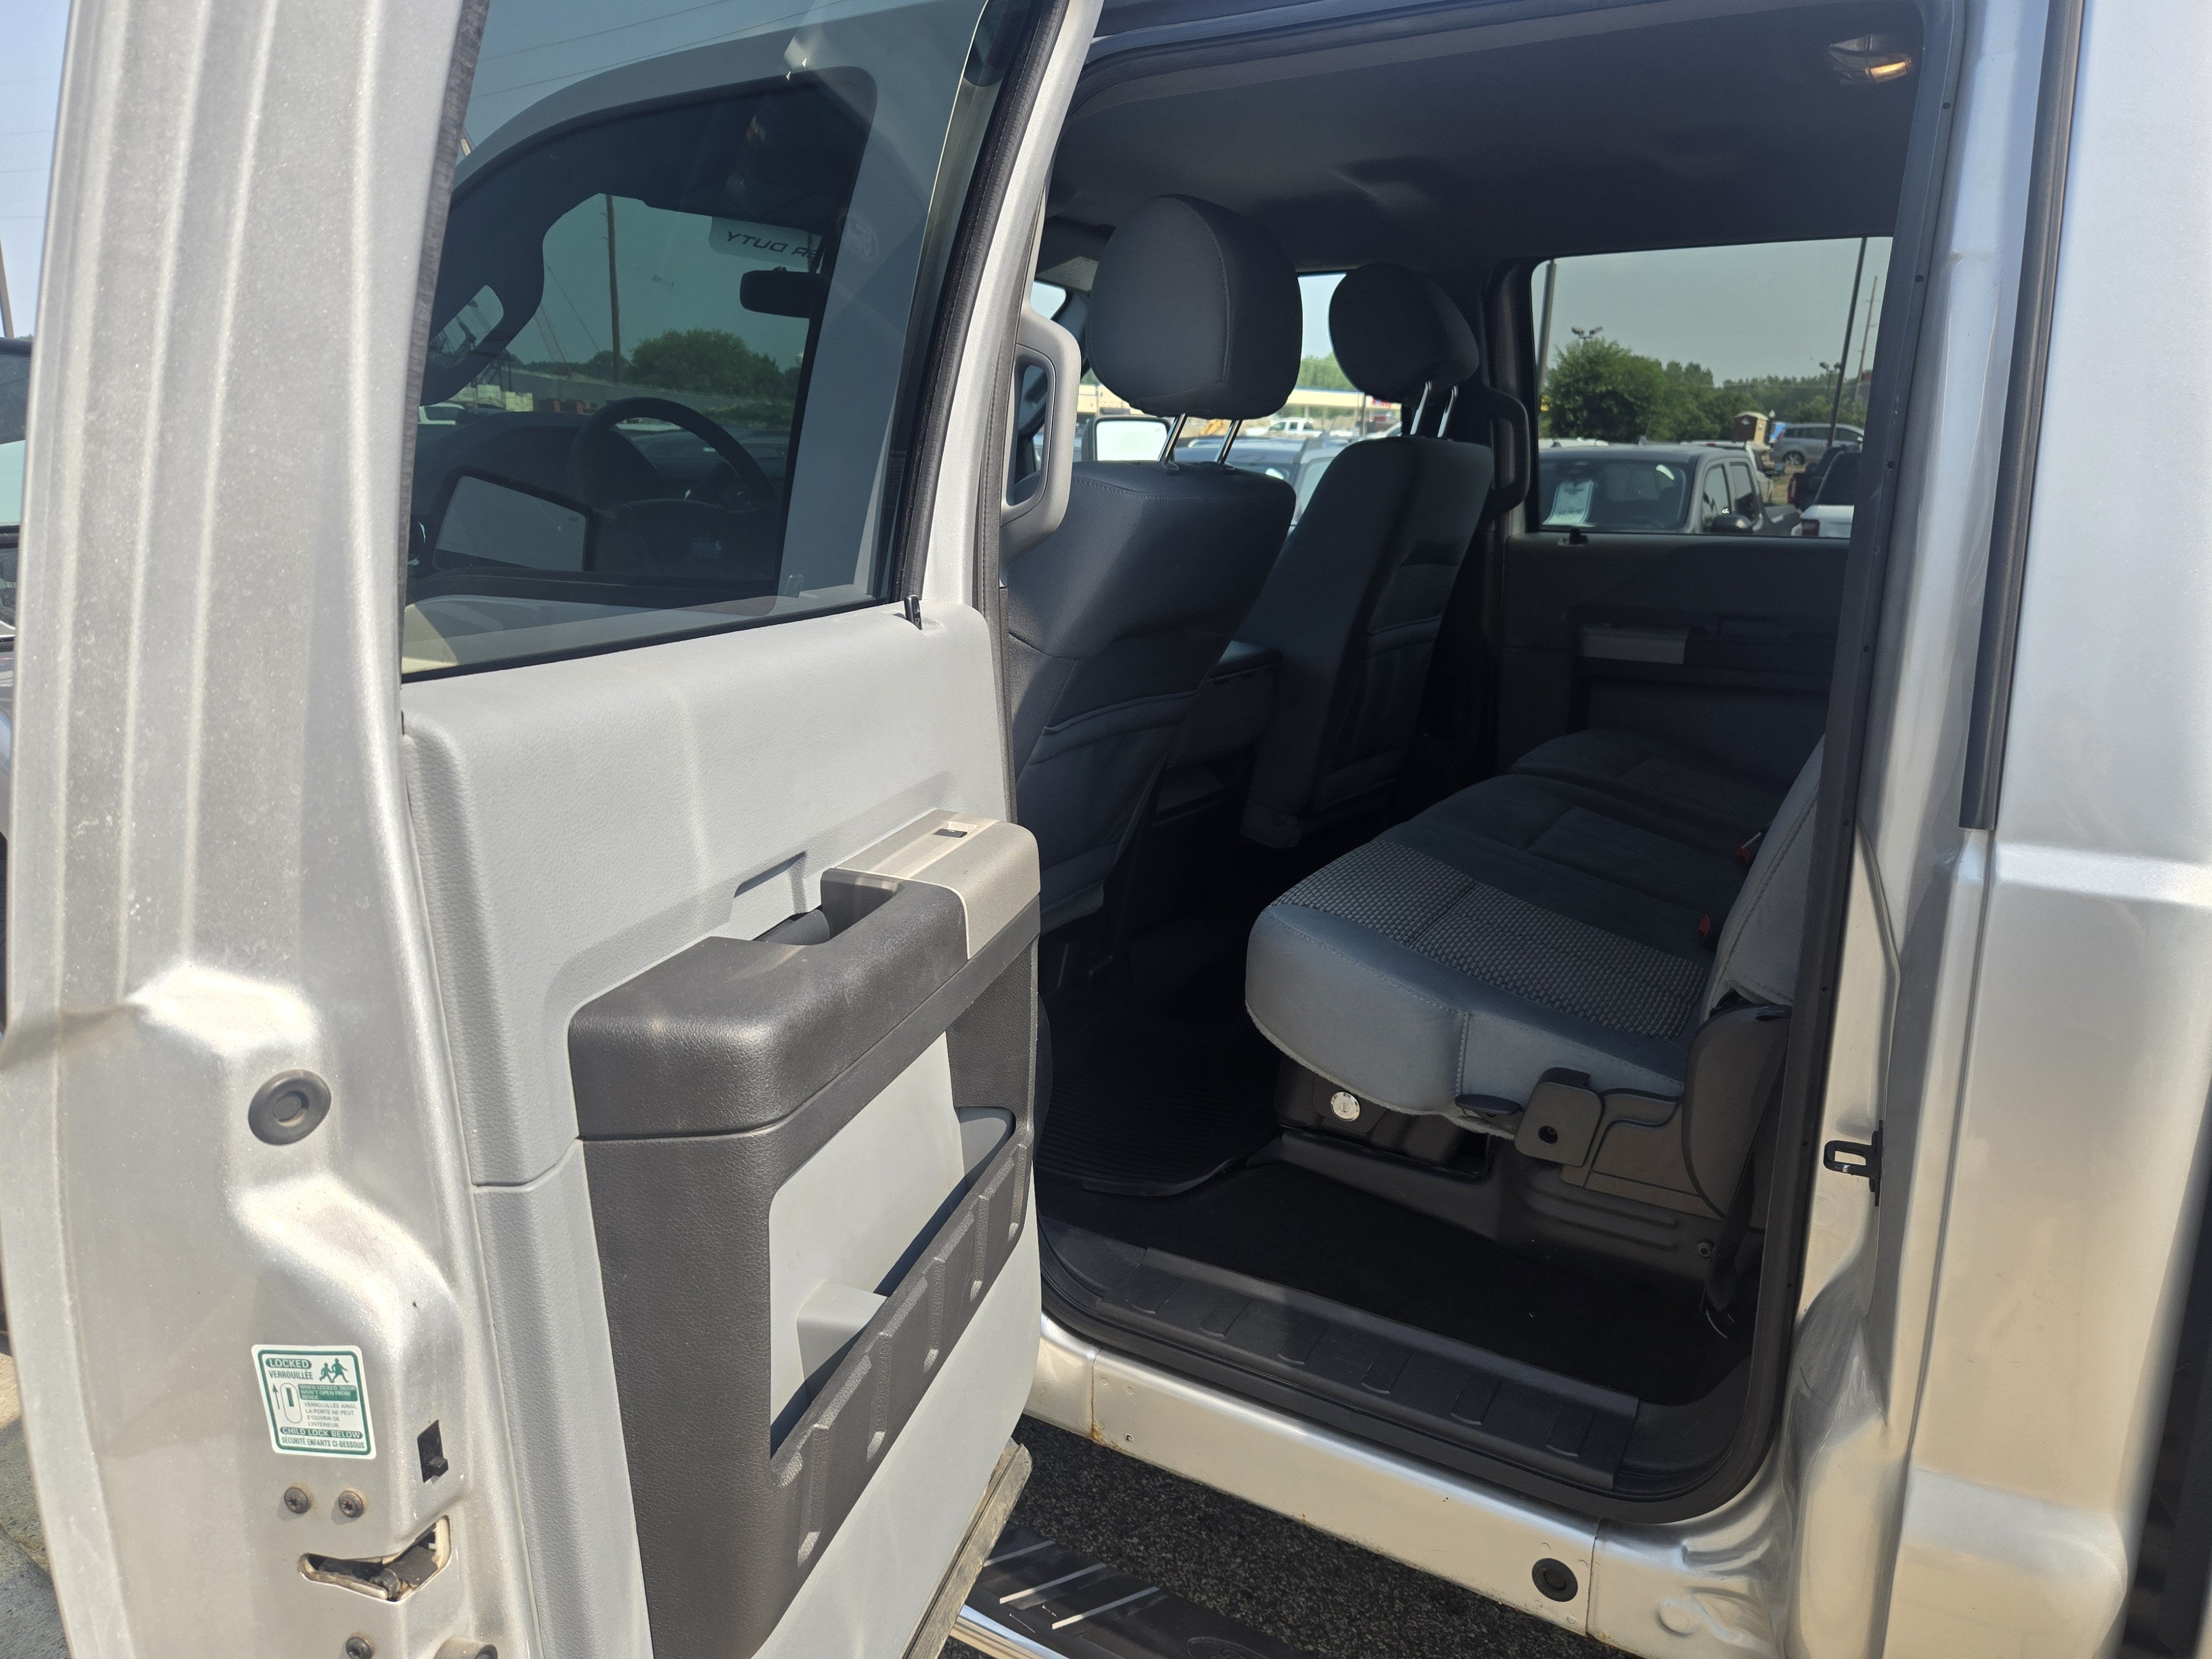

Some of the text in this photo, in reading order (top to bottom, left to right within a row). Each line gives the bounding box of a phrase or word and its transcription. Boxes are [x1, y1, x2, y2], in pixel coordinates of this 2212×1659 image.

[269, 1359, 309, 1368] LOCKED
[268, 1370, 314, 1379] VERROUILLÉE
[282, 1436, 306, 1445] SÉCURITÉ
